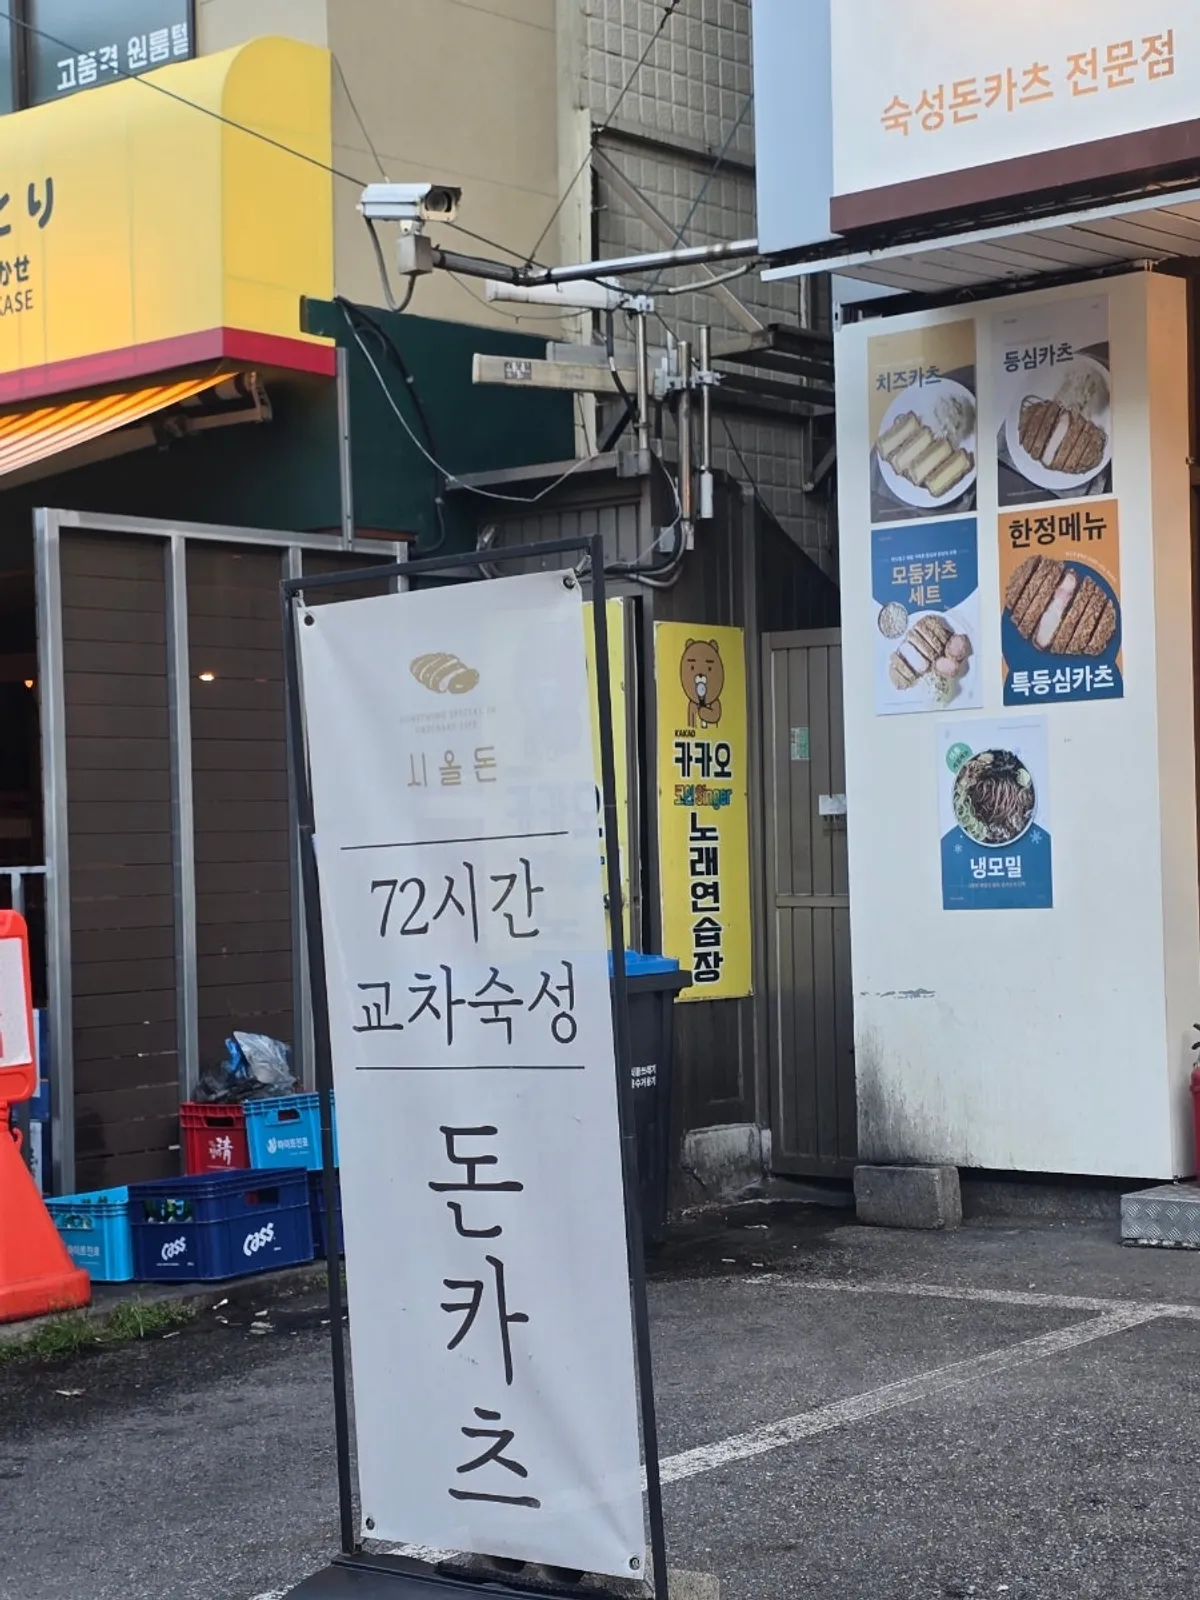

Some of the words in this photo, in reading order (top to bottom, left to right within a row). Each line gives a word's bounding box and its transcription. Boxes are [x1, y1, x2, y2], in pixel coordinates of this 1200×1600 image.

[57, 44, 119, 91] 고품격
[880, 61, 1054, 136] 숙성돈카츠
[1066, 29, 1175, 97] 전문점
[0, 289, 33, 316] ASE
[1003, 342, 1074, 373] 등심카츠
[876, 365, 942, 393] 치즈카츠
[1009, 512, 1107, 549] 한정메뉴
[891, 560, 958, 585] 모둠카츠
[908, 585, 942, 606] 세트
[1011, 664, 1115, 697] 특등심카츠
[674, 741, 732, 778] 카카오
[970, 856, 1022, 879] 냉모밀
[370, 857, 545, 943] 72시간
[689, 812, 724, 983] 노래연습장
[352, 960, 578, 1046] 교차숙성
[428, 1124, 542, 1509] 돈카츠
